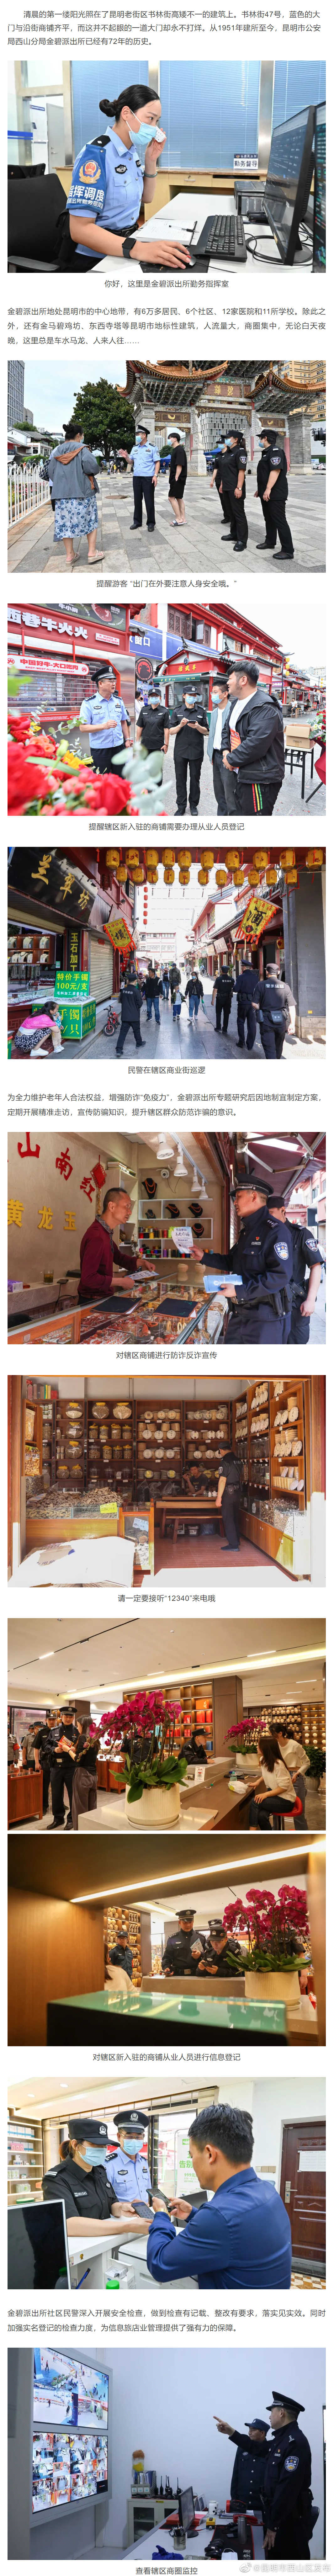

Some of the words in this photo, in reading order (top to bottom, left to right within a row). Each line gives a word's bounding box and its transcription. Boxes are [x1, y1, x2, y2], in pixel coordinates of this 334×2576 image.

[247, 906, 267, 927] 酒
[70, 932, 78, 971] 玉石加工
[57, 973, 88, 981] 特价手镯
[8, 1199, 76, 1230] 黄龙玉
